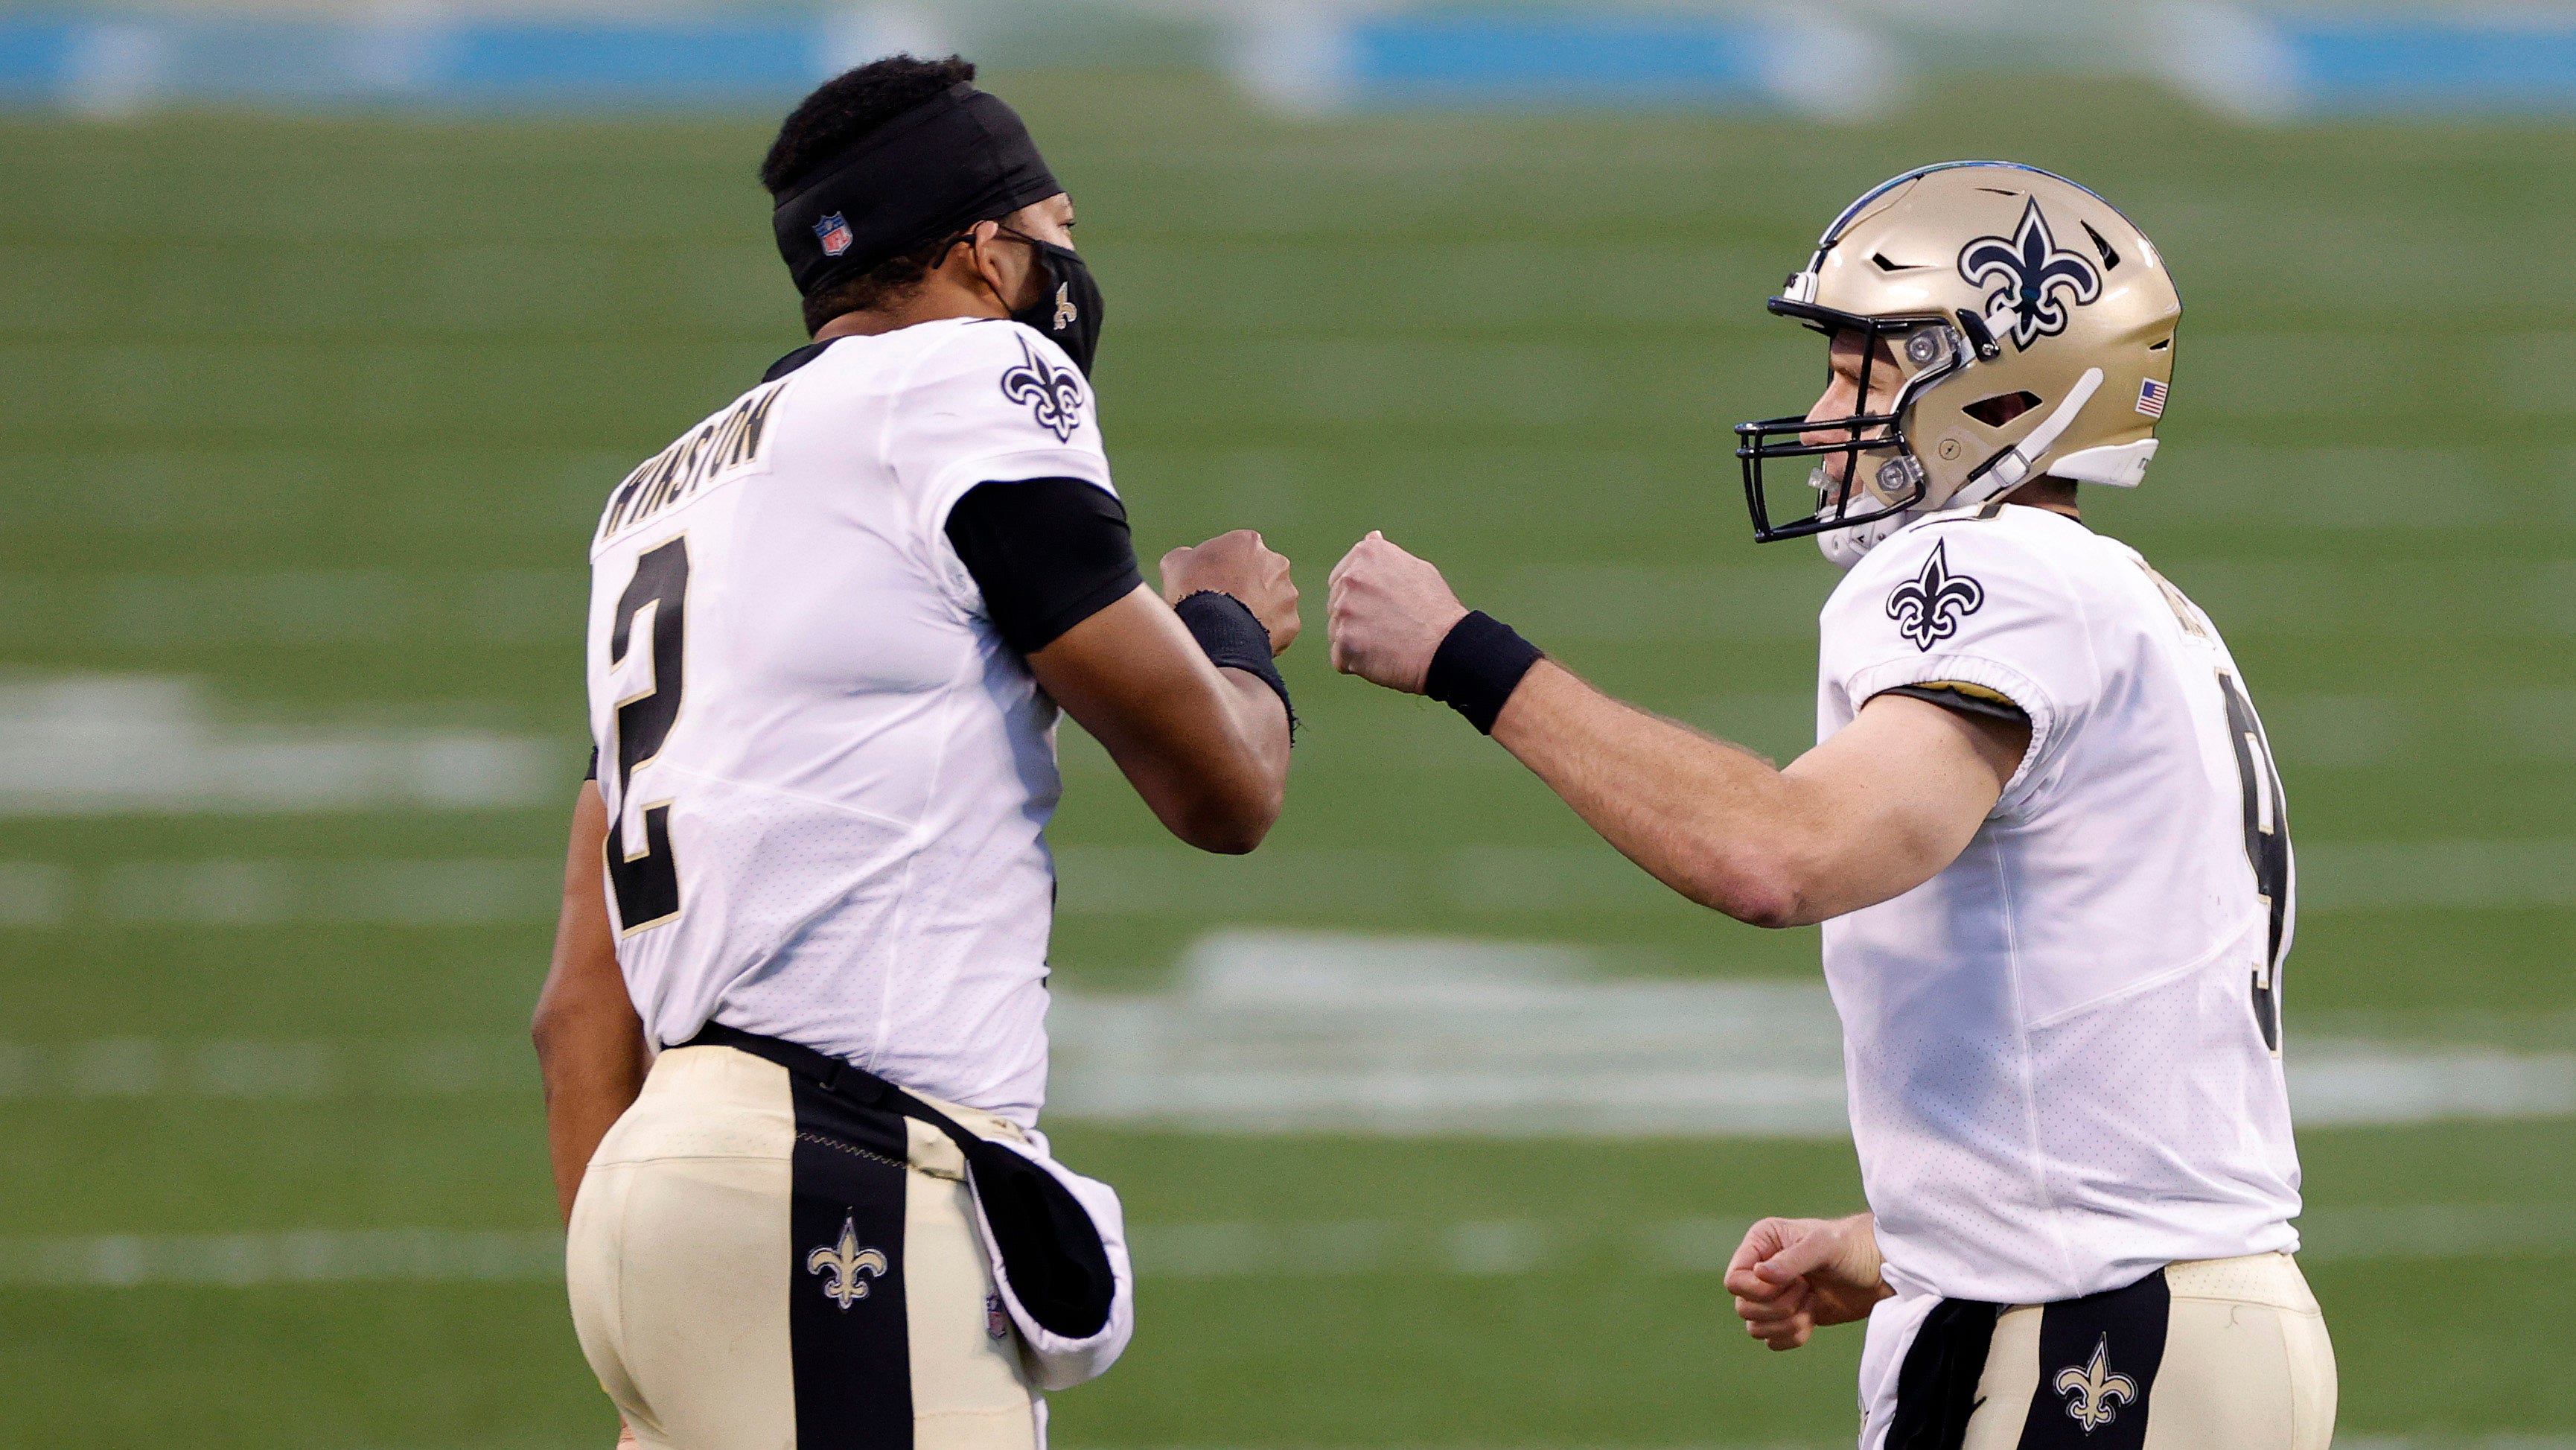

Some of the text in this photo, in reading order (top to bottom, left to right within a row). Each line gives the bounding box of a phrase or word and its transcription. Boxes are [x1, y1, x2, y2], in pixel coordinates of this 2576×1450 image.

[602, 380, 790, 542] WINSTON
[602, 530, 692, 940] 2
[2215, 667, 2288, 1058] 9
